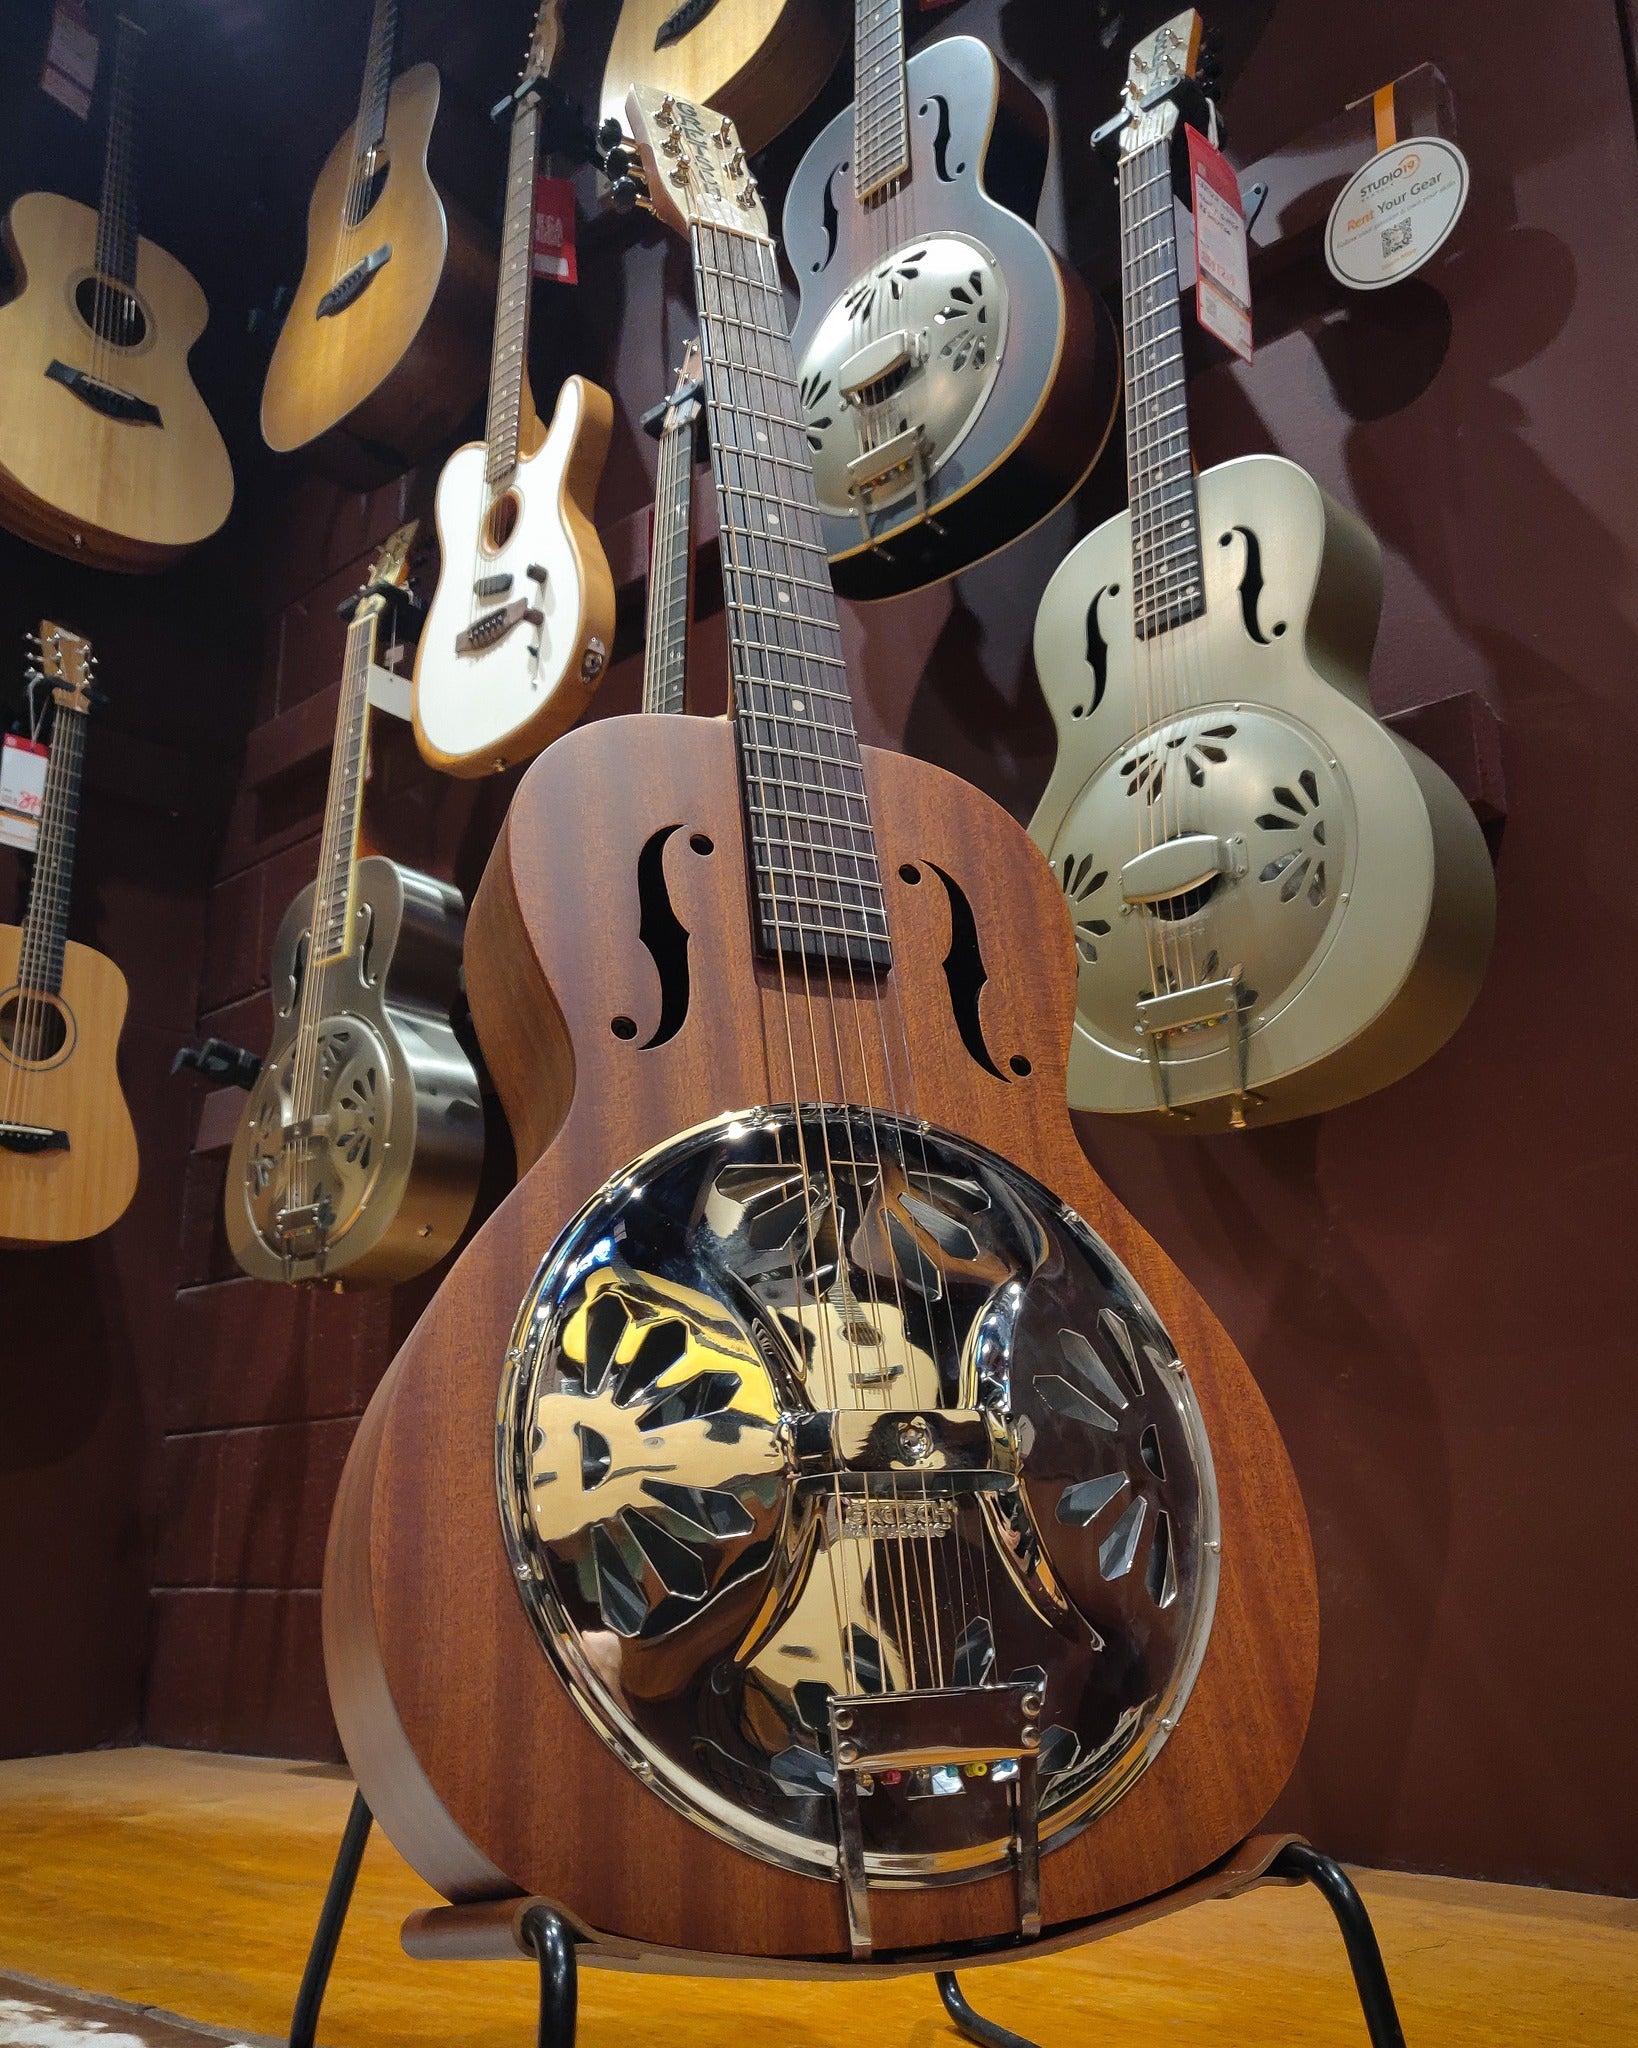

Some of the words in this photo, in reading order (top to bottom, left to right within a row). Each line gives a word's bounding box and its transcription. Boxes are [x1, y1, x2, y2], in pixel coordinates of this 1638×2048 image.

[676, 101, 721, 201] GRETSCH
[1348, 210, 1374, 232] Rent
[1378, 192, 1407, 214] Your
[1411, 172, 1442, 196] Gear
